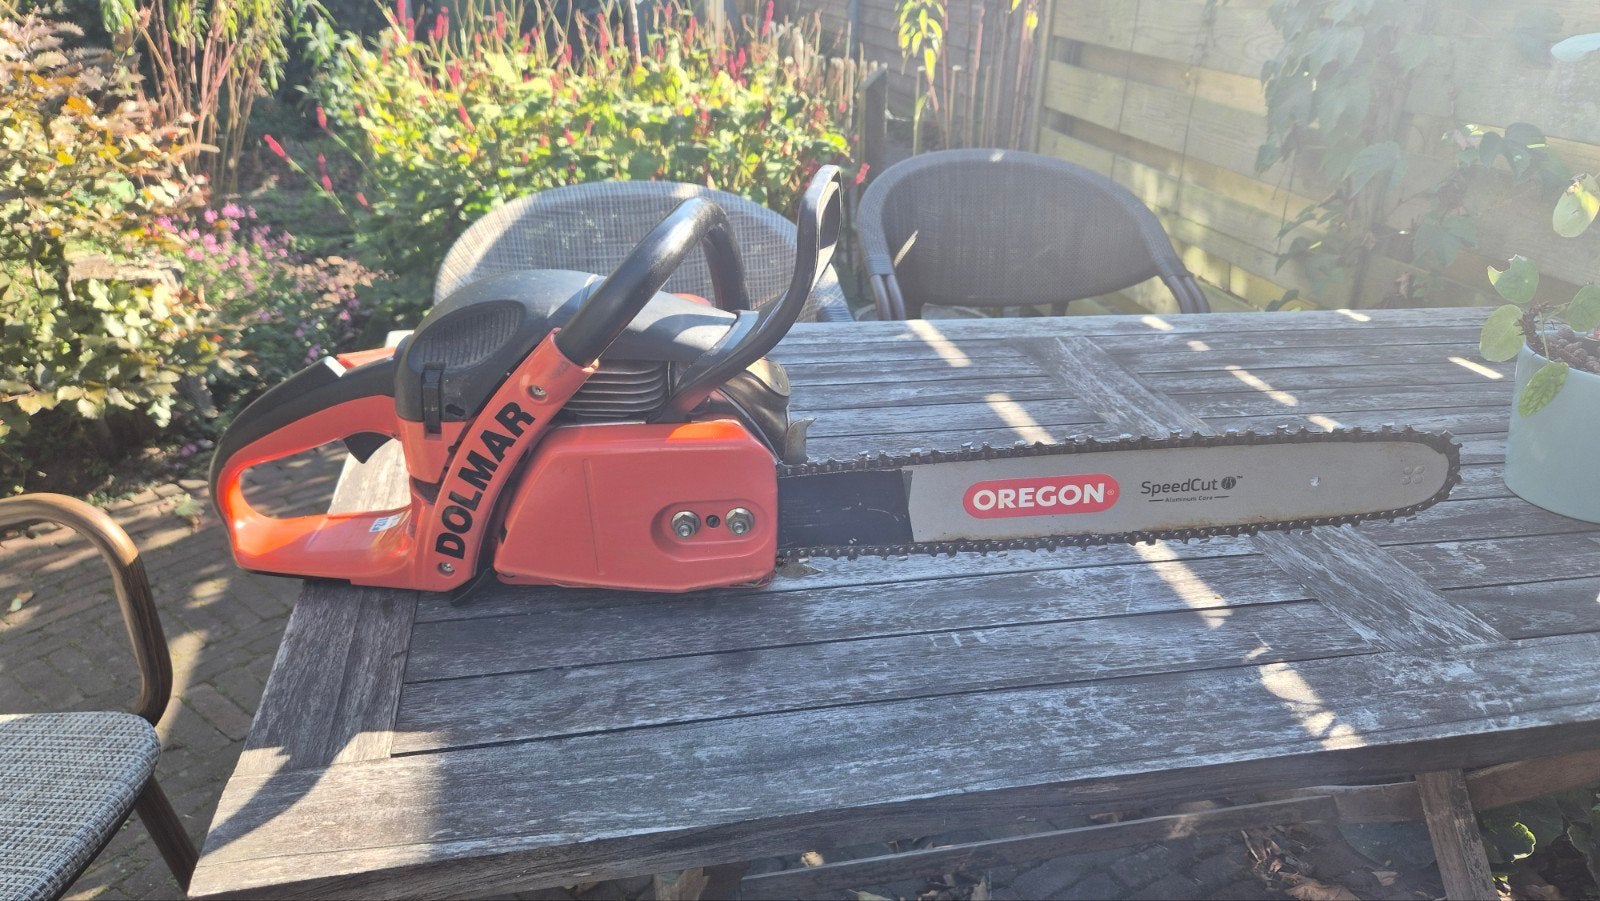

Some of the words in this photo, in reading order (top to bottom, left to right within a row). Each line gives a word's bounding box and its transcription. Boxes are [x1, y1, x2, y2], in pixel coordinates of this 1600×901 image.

[435, 402, 536, 559] DOLMAR
[1141, 478, 1218, 497] SpeedCut
[972, 483, 1105, 511] OREGON
